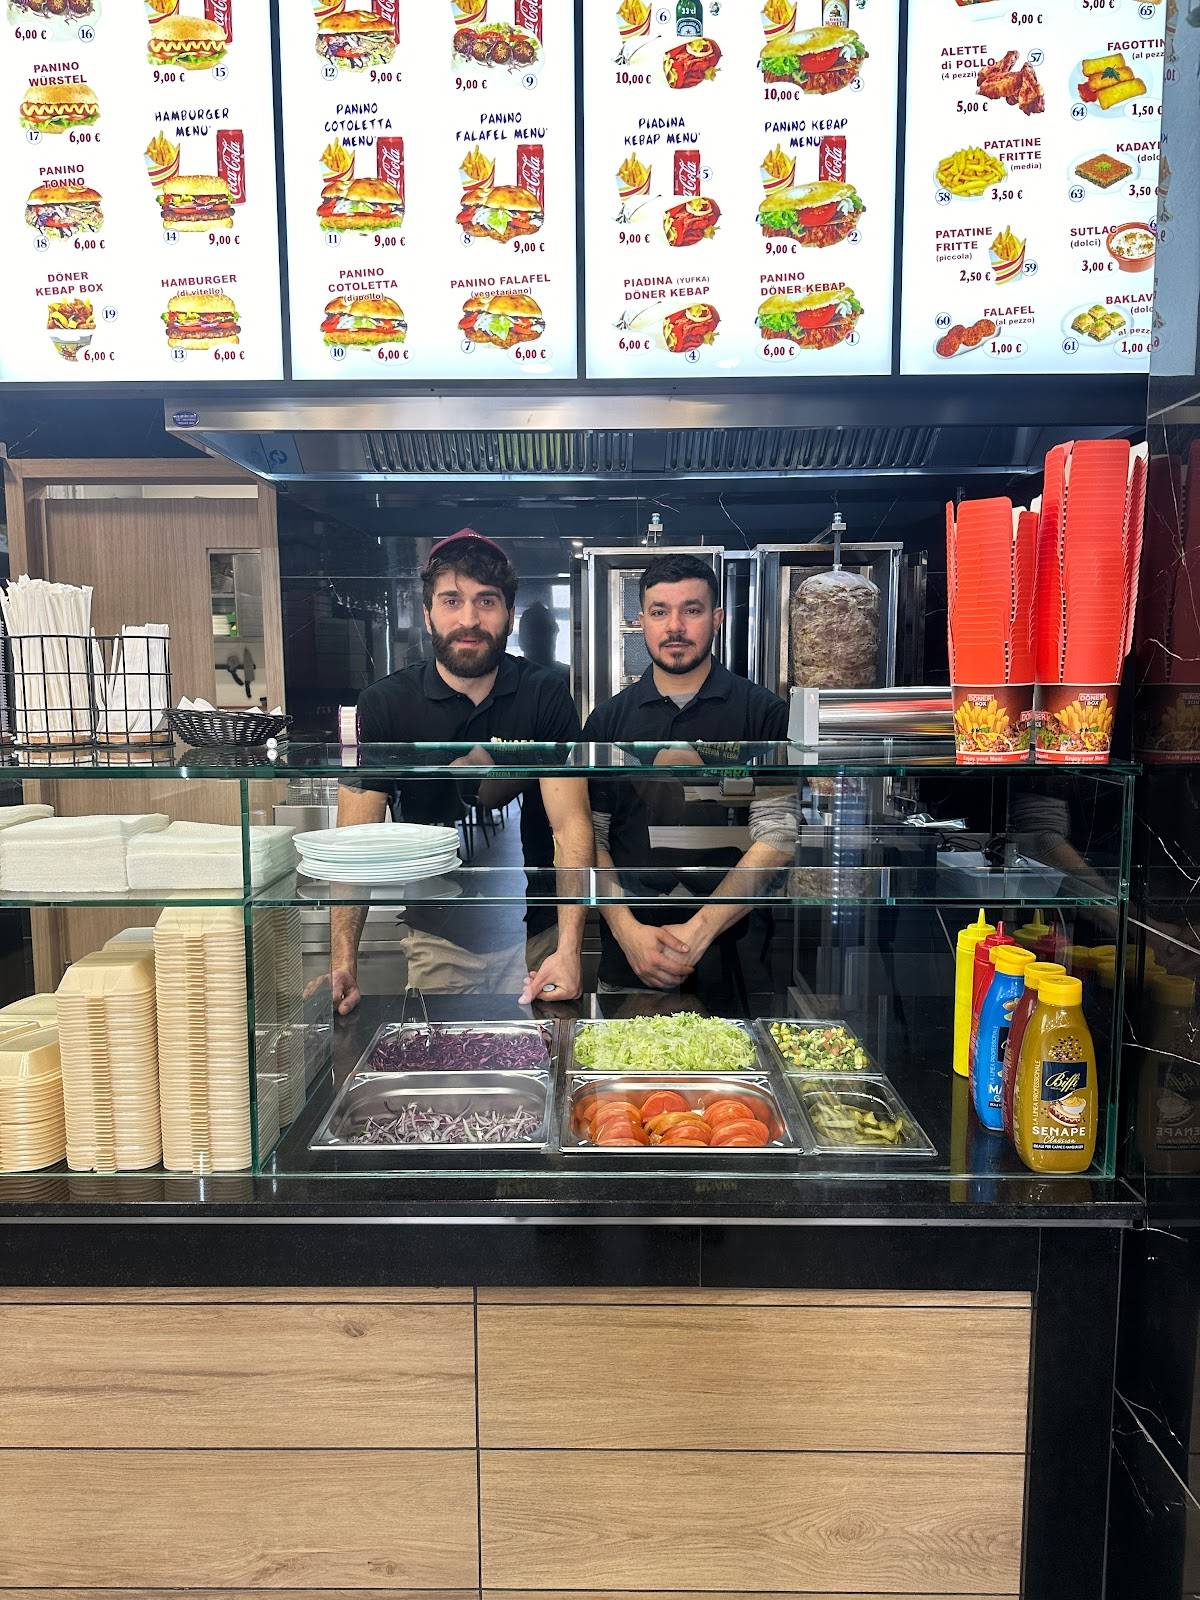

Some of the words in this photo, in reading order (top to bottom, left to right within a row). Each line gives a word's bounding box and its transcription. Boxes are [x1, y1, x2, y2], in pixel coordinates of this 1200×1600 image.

[1140, 6, 1152, 16] 65
[660, 12, 666, 22] 6
[1011, 12, 1033, 25] 8,00
[1037, 15, 1042, 23] €
[15, 27, 37, 40] 6,00
[40, 30, 46, 39] €
[80, 29, 92, 38] 16
[941, 45, 987, 56] ALETTE
[1030, 53, 1041, 62] 57
[34, 61, 79, 72] PANINO
[941, 60, 951, 69] di
[957, 58, 994, 68] POLLO
[154, 71, 175, 82] 9,00
[179, 73, 185, 82] €
[215, 67, 226, 76] 15
[324, 68, 335, 77] 12
[370, 70, 392, 82] 9,00
[396, 72, 401, 81] €
[942, 72, 949, 80] (4
[952, 70, 977, 80] pezzi)
[29, 74, 87, 86] WÜRSTEL
[456, 77, 478, 90] 9,00
[482, 80, 487, 89] €
[526, 77, 533, 86] 9
[615, 72, 644, 86] 10,00
[646, 75, 651, 84] €
[854, 79, 860, 89] 3
[764, 88, 792, 102] 10,00
[794, 91, 799, 100] €
[336, 103, 377, 114] PANINO
[956, 101, 980, 113] 5,00
[982, 103, 988, 111] €
[1132, 104, 1154, 117] 1,50
[155, 107, 228, 121] HAMBURGER
[480, 112, 521, 124] PANINO
[1072, 109, 1085, 118] 64
[324, 119, 392, 131] COTOLETTA
[638, 117, 685, 129] PIADINA
[764, 120, 806, 132] PANINO
[812, 119, 848, 130] KEBAP
[29, 131, 39, 141] 17
[69, 132, 91, 143] 6,00
[94, 134, 100, 142] €
[456, 130, 507, 141] FALAFEL
[624, 134, 660, 146] KEBAP
[984, 138, 1041, 149] PATATINE
[1000, 151, 1041, 161] FRITTE
[39, 164, 84, 175] PANINO
[1011, 162, 1042, 172] (media)
[702, 169, 709, 179] 5
[43, 178, 84, 189] TONNO
[991, 189, 1013, 201] 3,50
[1017, 190, 1022, 199] €
[1070, 189, 1083, 198] 63
[1129, 184, 1151, 198] 3,50
[938, 192, 949, 202] 58
[166, 232, 176, 241] 14
[328, 234, 337, 243] 11
[464, 234, 470, 243] 8
[619, 231, 641, 244] 9,00
[644, 234, 650, 242] €
[852, 233, 858, 242] 2
[936, 227, 992, 239] PATATINE
[36, 239, 47, 248] 18
[74, 238, 96, 250] 6,00
[100, 240, 105, 248] €
[209, 233, 231, 245] 9,00
[234, 235, 240, 244] €
[374, 235, 396, 247] 9,00
[400, 237, 405, 246] €
[1070, 239, 1101, 248] (dolci)
[514, 241, 536, 253] 9,00
[539, 243, 545, 252] €
[766, 242, 788, 255] 9,00
[791, 244, 796, 254] €
[936, 241, 978, 251] FRITTE
[936, 253, 972, 262] (piccola)
[1025, 263, 1036, 272] 59
[1082, 261, 1104, 273] 3,00
[1107, 262, 1113, 271] €
[48, 272, 88, 282] DÖNER
[340, 268, 384, 278] PANINO
[760, 272, 804, 283] PANINO
[960, 270, 983, 282] 2,50
[985, 272, 990, 280] €
[161, 274, 237, 287] HAMBURGER
[328, 280, 398, 292] COTOLETTA
[450, 277, 495, 288] PANINO
[500, 274, 550, 285] FALAFEL
[624, 276, 672, 288] PIADINA
[677, 276, 710, 284] (YUFKA)
[36, 285, 74, 296] KEBAP
[80, 283, 103, 294] BOX
[471, 287, 532, 298] (vegetariano)
[625, 288, 666, 300] DÖNER
[670, 286, 710, 297] KEBAP
[760, 284, 802, 295] DÖNER
[806, 282, 845, 292] KEBAP
[105, 309, 116, 319] 19
[984, 306, 1034, 317] FALAFEL
[938, 316, 949, 325] 60
[1008, 317, 1034, 325] pezzo)
[851, 334, 854, 342] 1
[465, 341, 470, 351] 7
[619, 339, 641, 351] 6,00
[644, 341, 649, 349] €
[991, 342, 1013, 353] 1,00
[1016, 344, 1021, 352] €
[1065, 341, 1075, 350] 61
[1122, 342, 1143, 354] 1,00
[84, 350, 106, 361] 6,00
[109, 352, 115, 360] €
[174, 349, 184, 359] 13
[214, 349, 236, 360] 6,00
[239, 351, 245, 360] €
[333, 349, 343, 358] 10
[378, 349, 400, 360] 6,00
[403, 351, 408, 359] €
[515, 348, 537, 360] 6,00
[540, 350, 546, 359] €
[689, 352, 696, 360] 4
[764, 345, 787, 358] 6,00
[789, 347, 794, 356] €
[1045, 1070, 1080, 1092] Biffi
[1032, 1126, 1085, 1136] SENAPE
